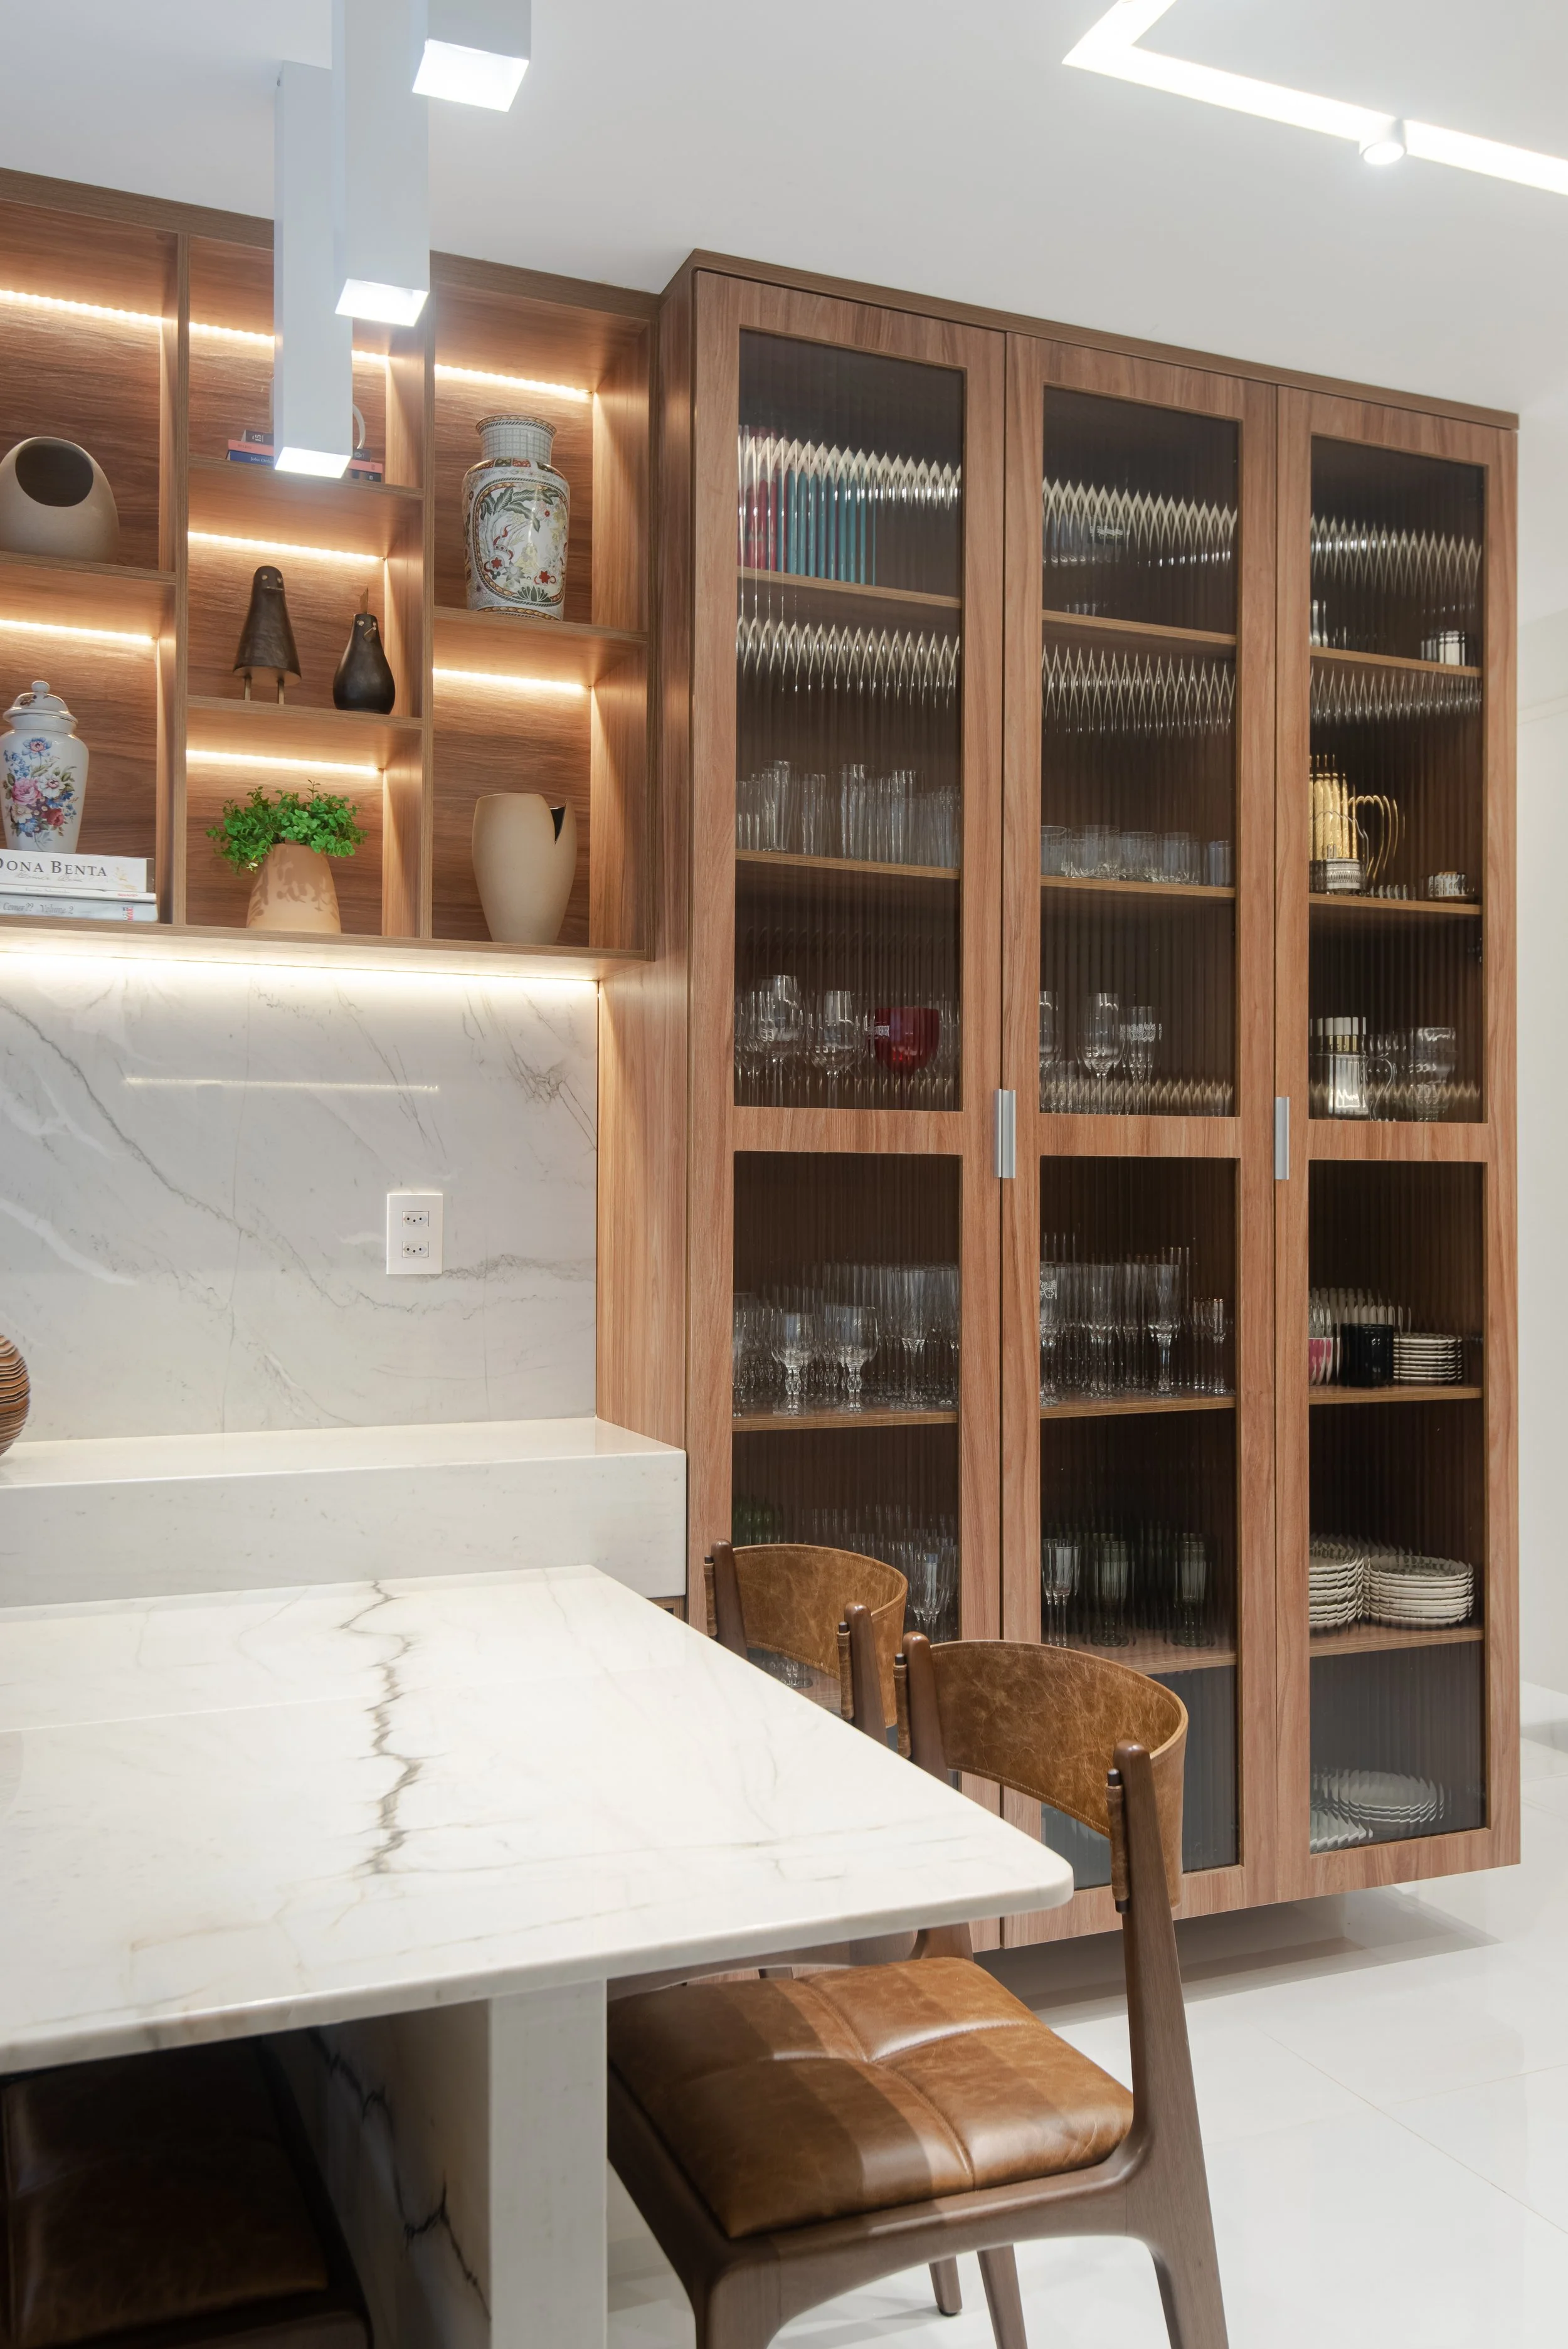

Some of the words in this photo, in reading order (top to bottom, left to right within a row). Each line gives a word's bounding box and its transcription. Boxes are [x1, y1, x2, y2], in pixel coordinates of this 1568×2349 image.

[51, 861, 107, 876] BENTA
[40, 904, 66, 914] Volume
[69, 906, 74, 915] 2
